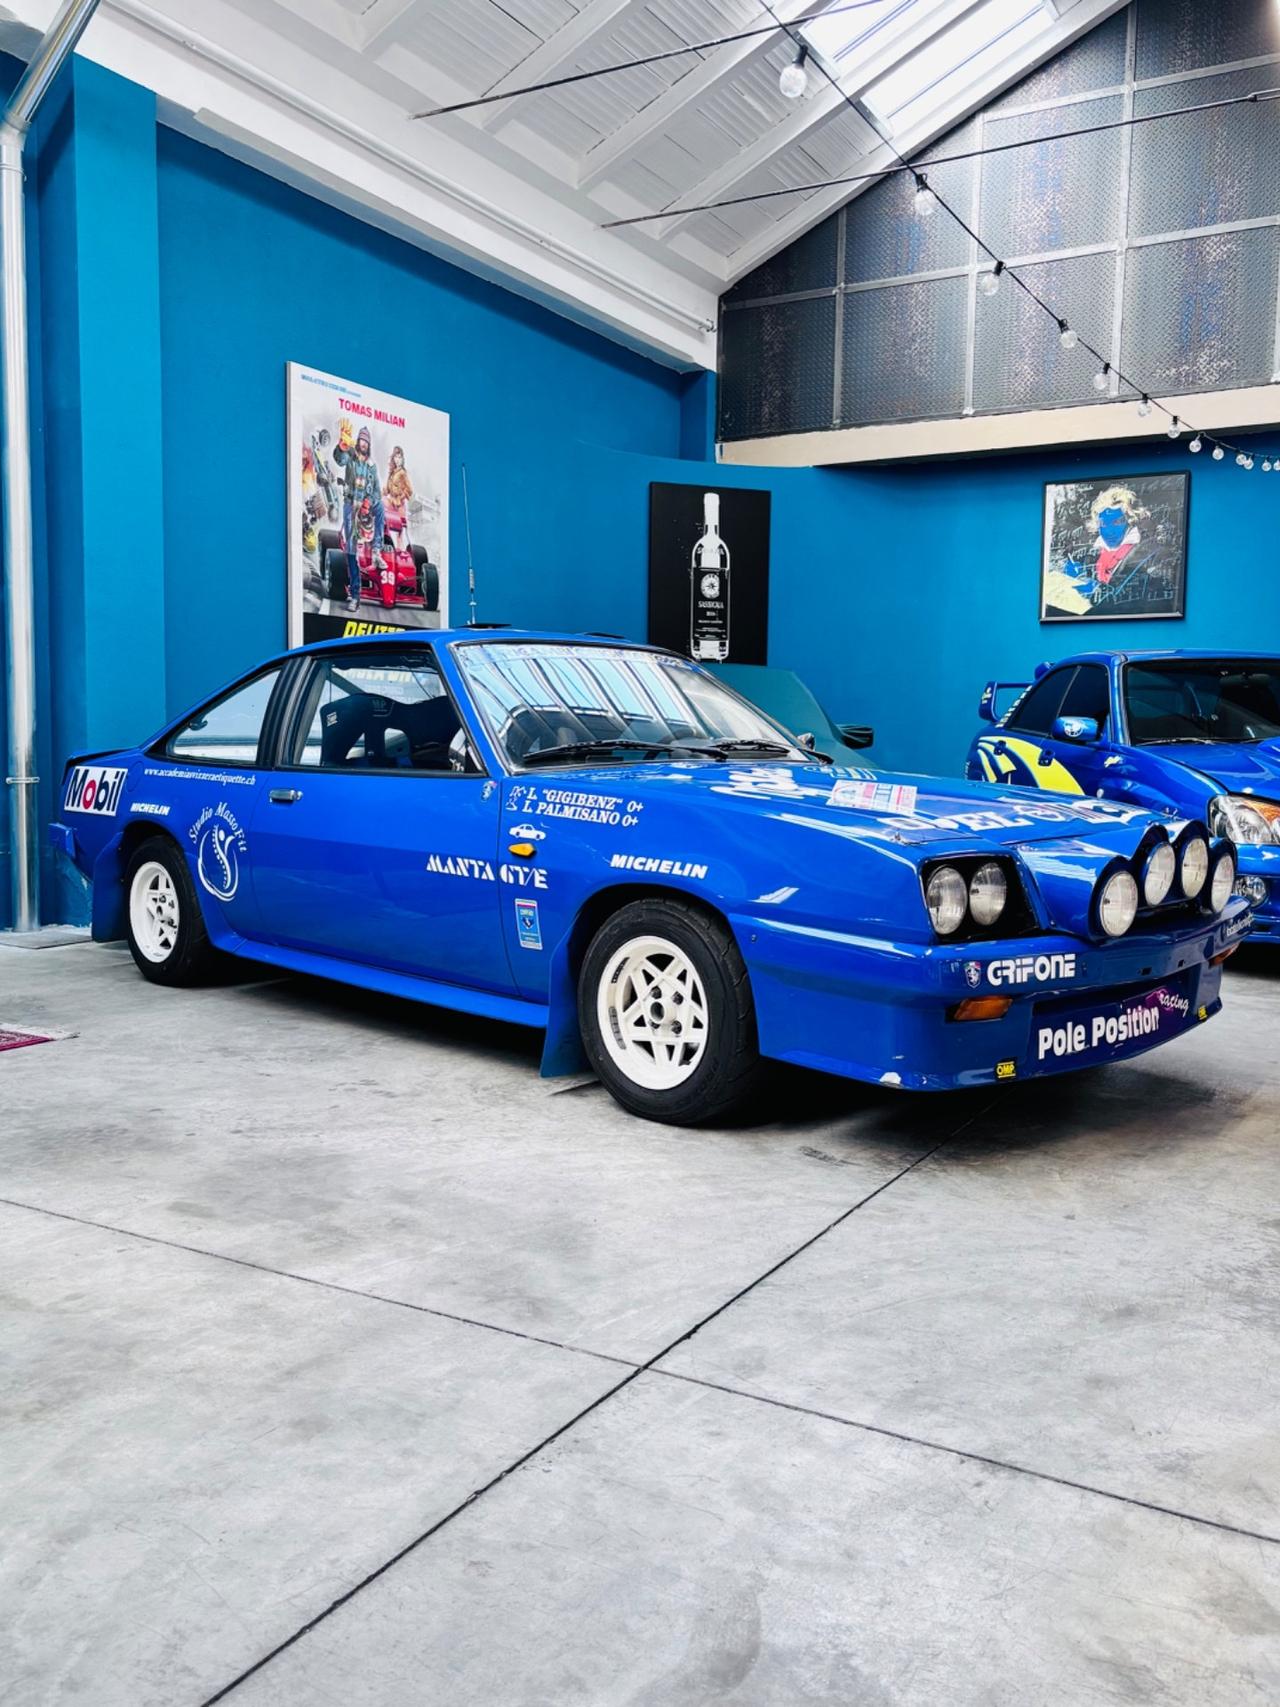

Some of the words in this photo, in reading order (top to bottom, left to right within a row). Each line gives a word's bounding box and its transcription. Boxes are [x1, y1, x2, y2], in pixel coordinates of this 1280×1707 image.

[339, 398, 373, 418] TOMAS
[374, 410, 405, 428] MILIAN
[381, 570, 395, 586] 39
[66, 769, 126, 812] Mobil
[535, 802, 619, 825] PALMISANO
[426, 854, 496, 882] MANTA
[610, 854, 708, 879] MICHELIN
[987, 953, 1076, 987] GRIFONE
[1038, 1021, 1086, 1060] Pole
[1092, 1004, 1160, 1046] Position
[996, 1064, 1015, 1075] OMP
